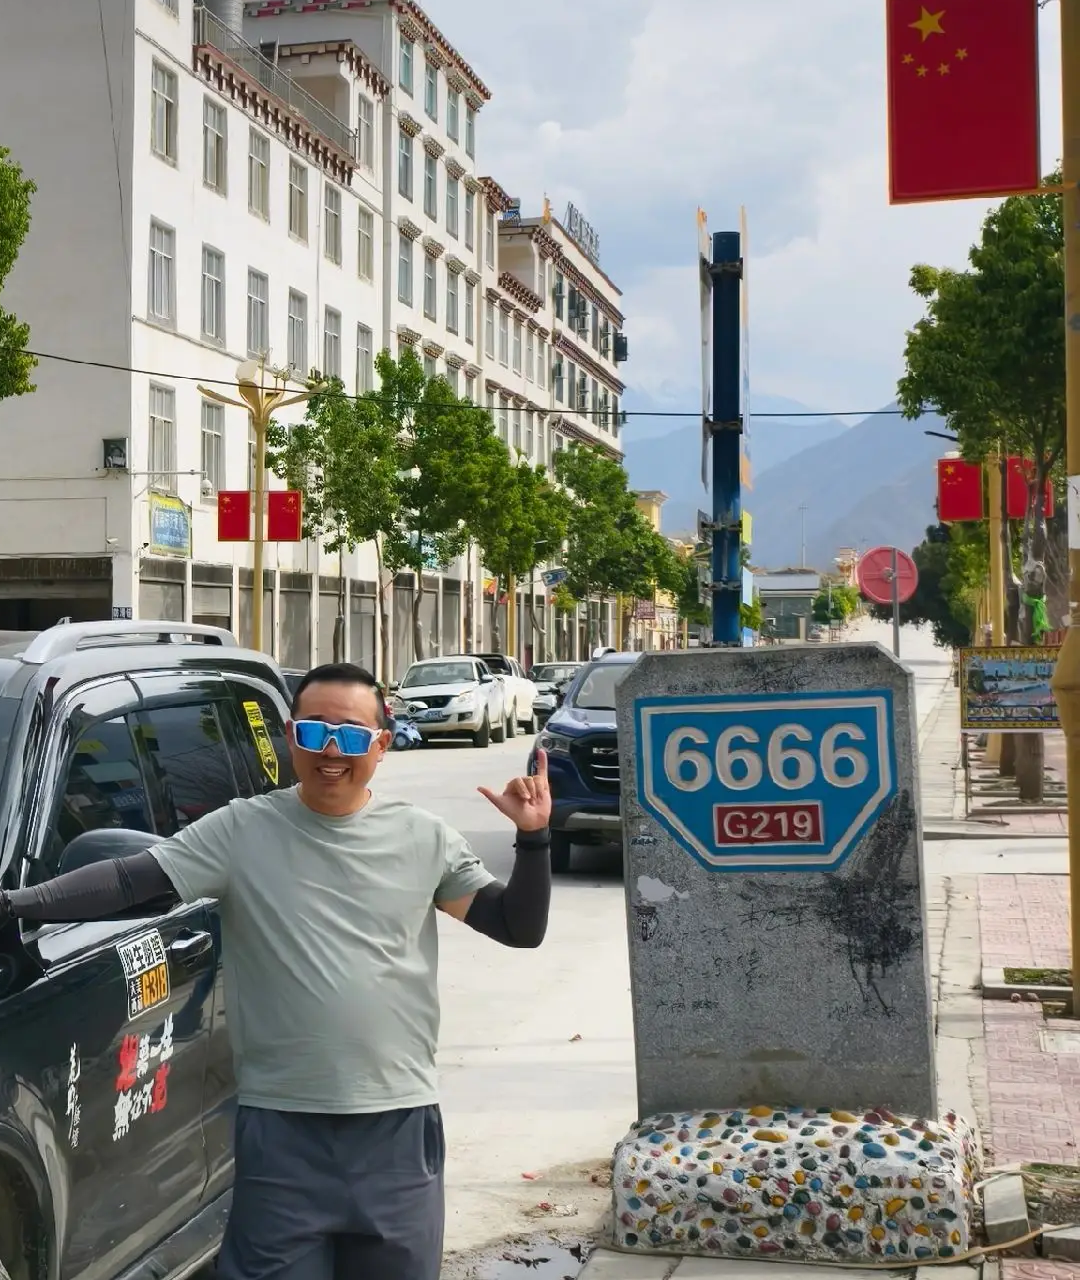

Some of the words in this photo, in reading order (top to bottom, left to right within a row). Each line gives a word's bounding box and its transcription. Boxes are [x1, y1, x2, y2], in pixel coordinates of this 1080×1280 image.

[664, 723, 869, 792] 6666
[723, 809, 813, 839] G219
[142, 963, 168, 1008] G318
